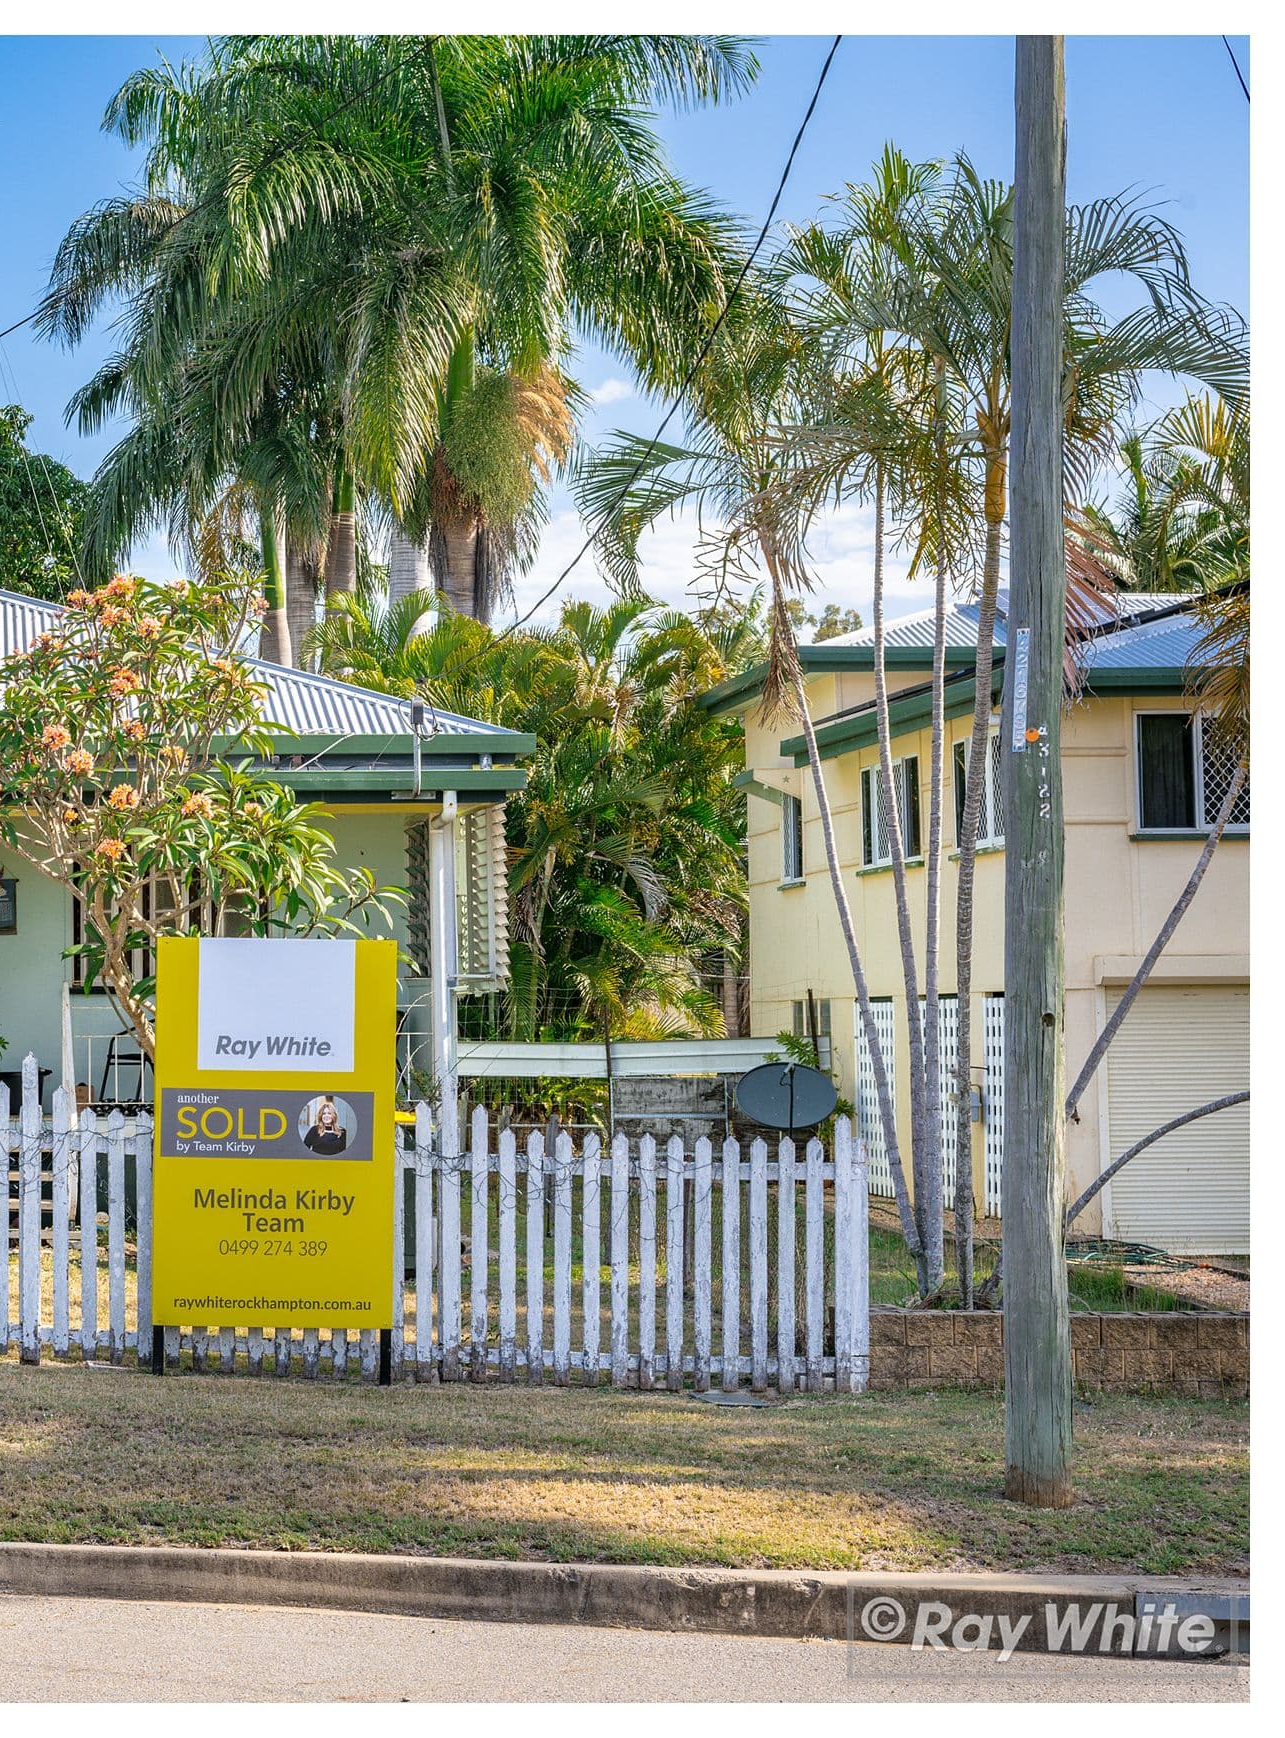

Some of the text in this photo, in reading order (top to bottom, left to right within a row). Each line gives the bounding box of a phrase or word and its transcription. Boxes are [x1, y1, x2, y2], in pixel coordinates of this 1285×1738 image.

[215, 1035, 331, 1059] Ray White
[177, 1093, 219, 1104] another
[176, 1106, 287, 1140] SOLD
[176, 1140, 256, 1155] by Team Kirby
[194, 1188, 355, 1216] Melinda Kirby
[242, 1212, 305, 1233] Team
[219, 1239, 328, 1257] 0499 274 389
[173, 1296, 372, 1312] raywhiterockhampton.com.au
